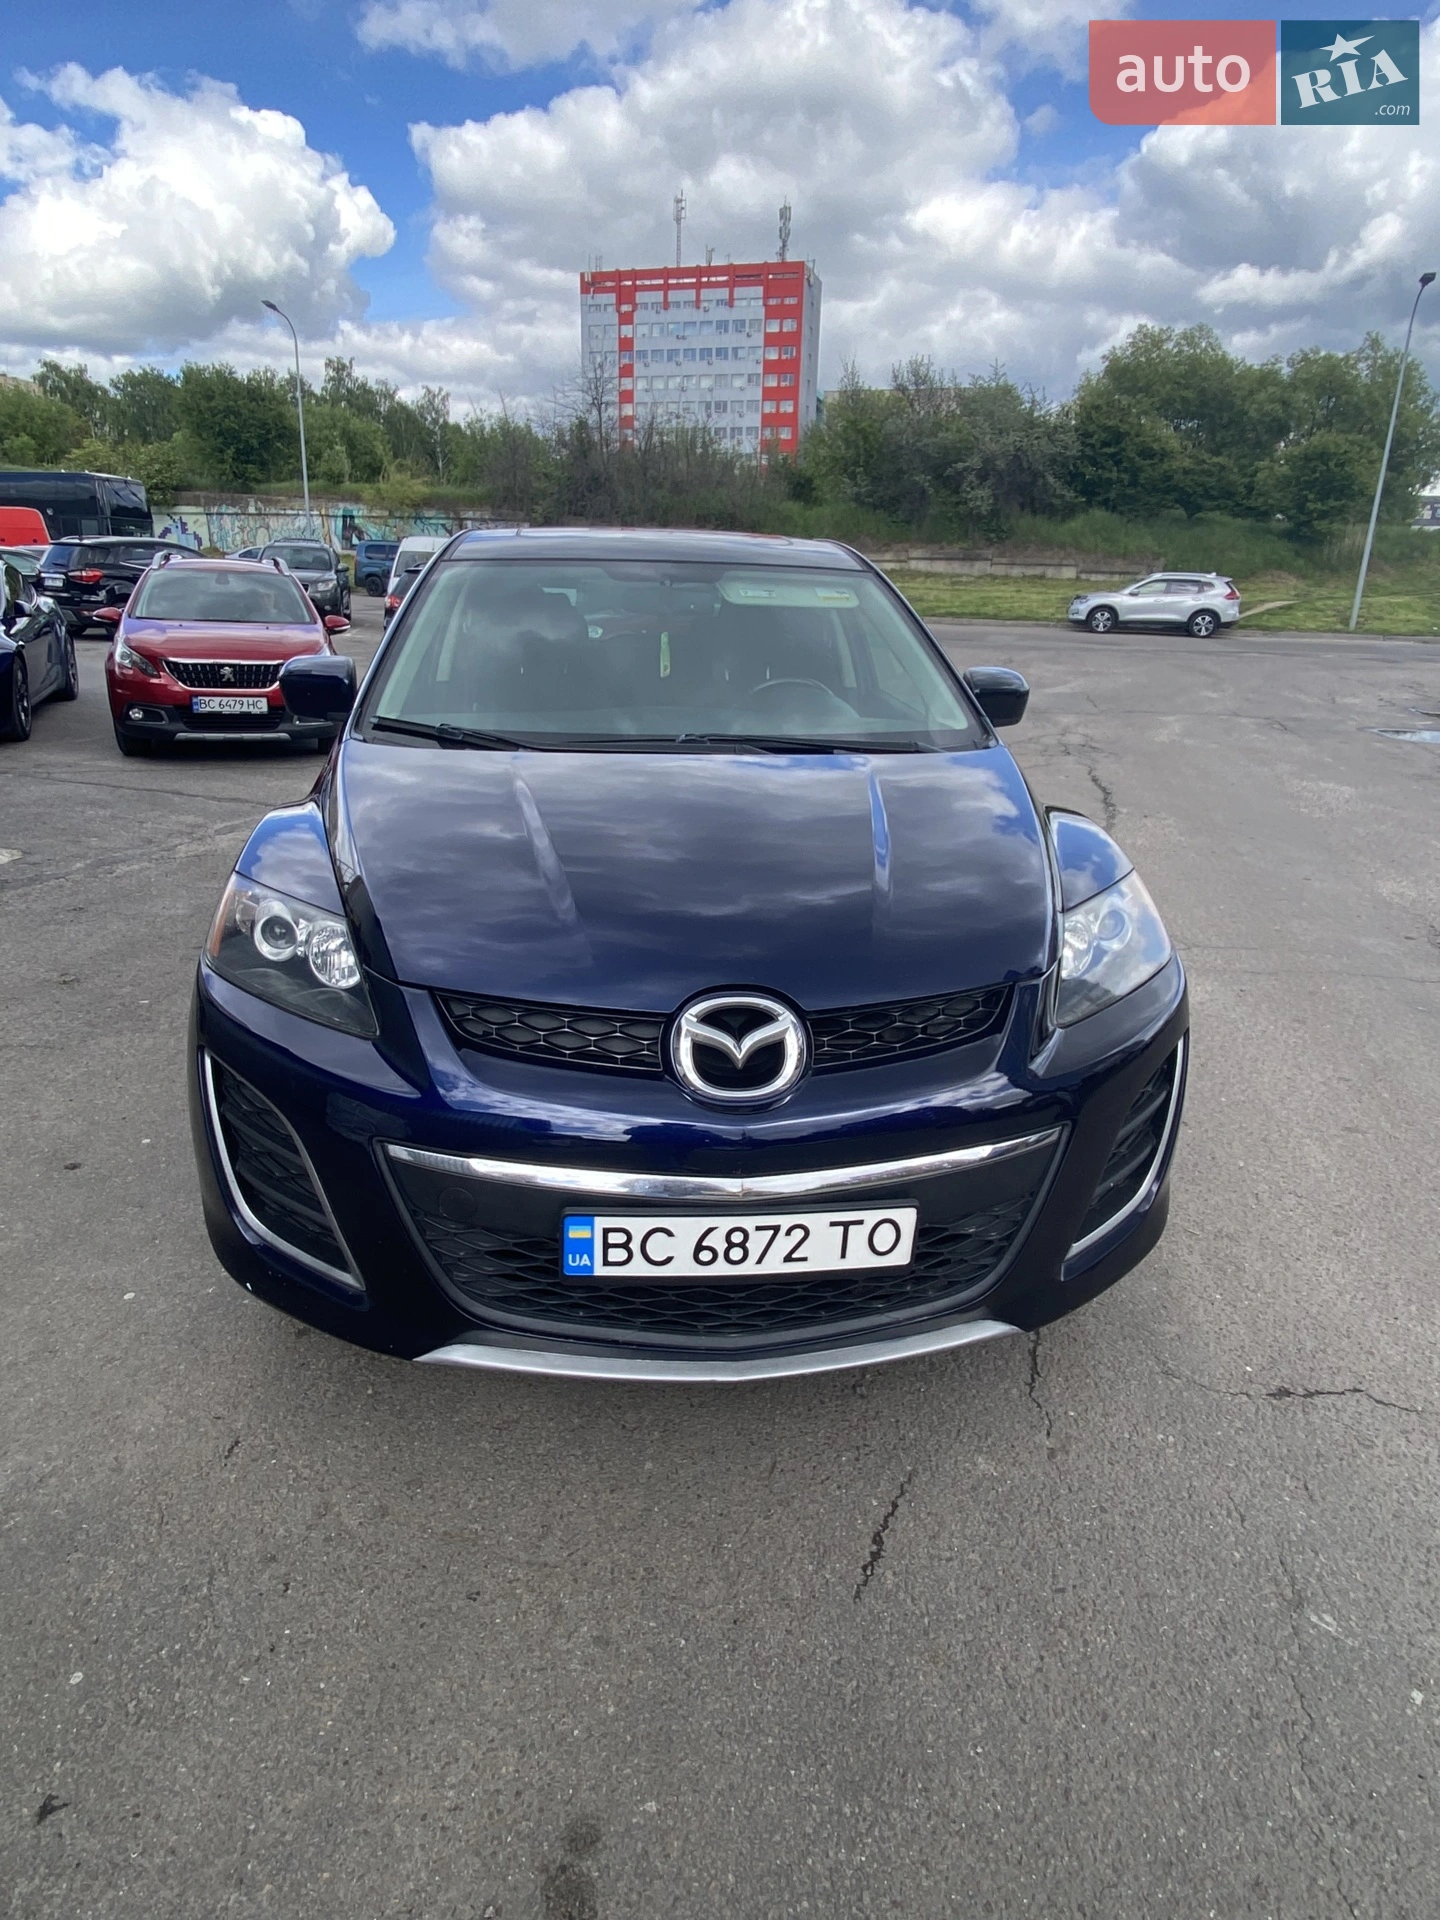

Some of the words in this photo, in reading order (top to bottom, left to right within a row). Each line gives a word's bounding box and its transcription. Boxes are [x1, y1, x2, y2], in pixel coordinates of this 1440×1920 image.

[199, 698, 216, 710] BC
[218, 698, 245, 710] 6479
[247, 699, 264, 710] HC
[602, 1226, 676, 1267] BC
[692, 1223, 811, 1267] 6872
[829, 1217, 902, 1260] TO
[568, 1253, 592, 1267] UA
